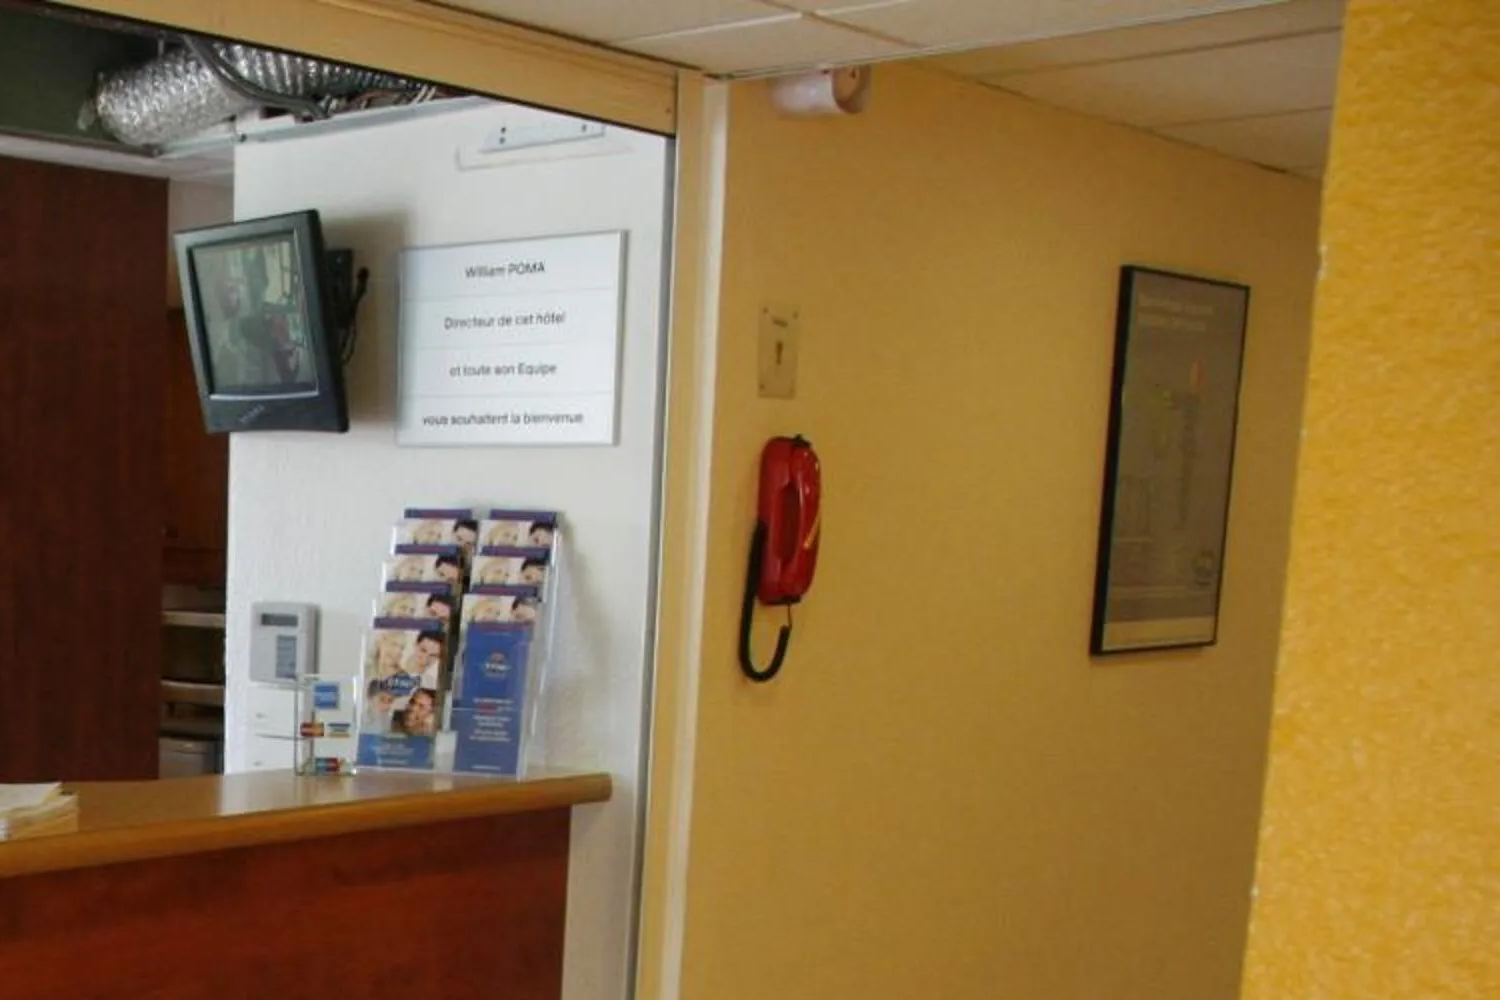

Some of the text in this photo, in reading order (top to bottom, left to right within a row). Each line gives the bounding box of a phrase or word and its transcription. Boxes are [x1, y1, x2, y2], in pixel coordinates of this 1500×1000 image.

[465, 261, 546, 279] William POMA
[444, 316, 495, 330] Directeur
[497, 316, 513, 327] de
[515, 314, 534, 326] cet
[449, 365, 462, 377] et
[463, 364, 491, 376] toute
[494, 365, 515, 375] son
[423, 411, 583, 425] vous souhaitent la bienvenue
